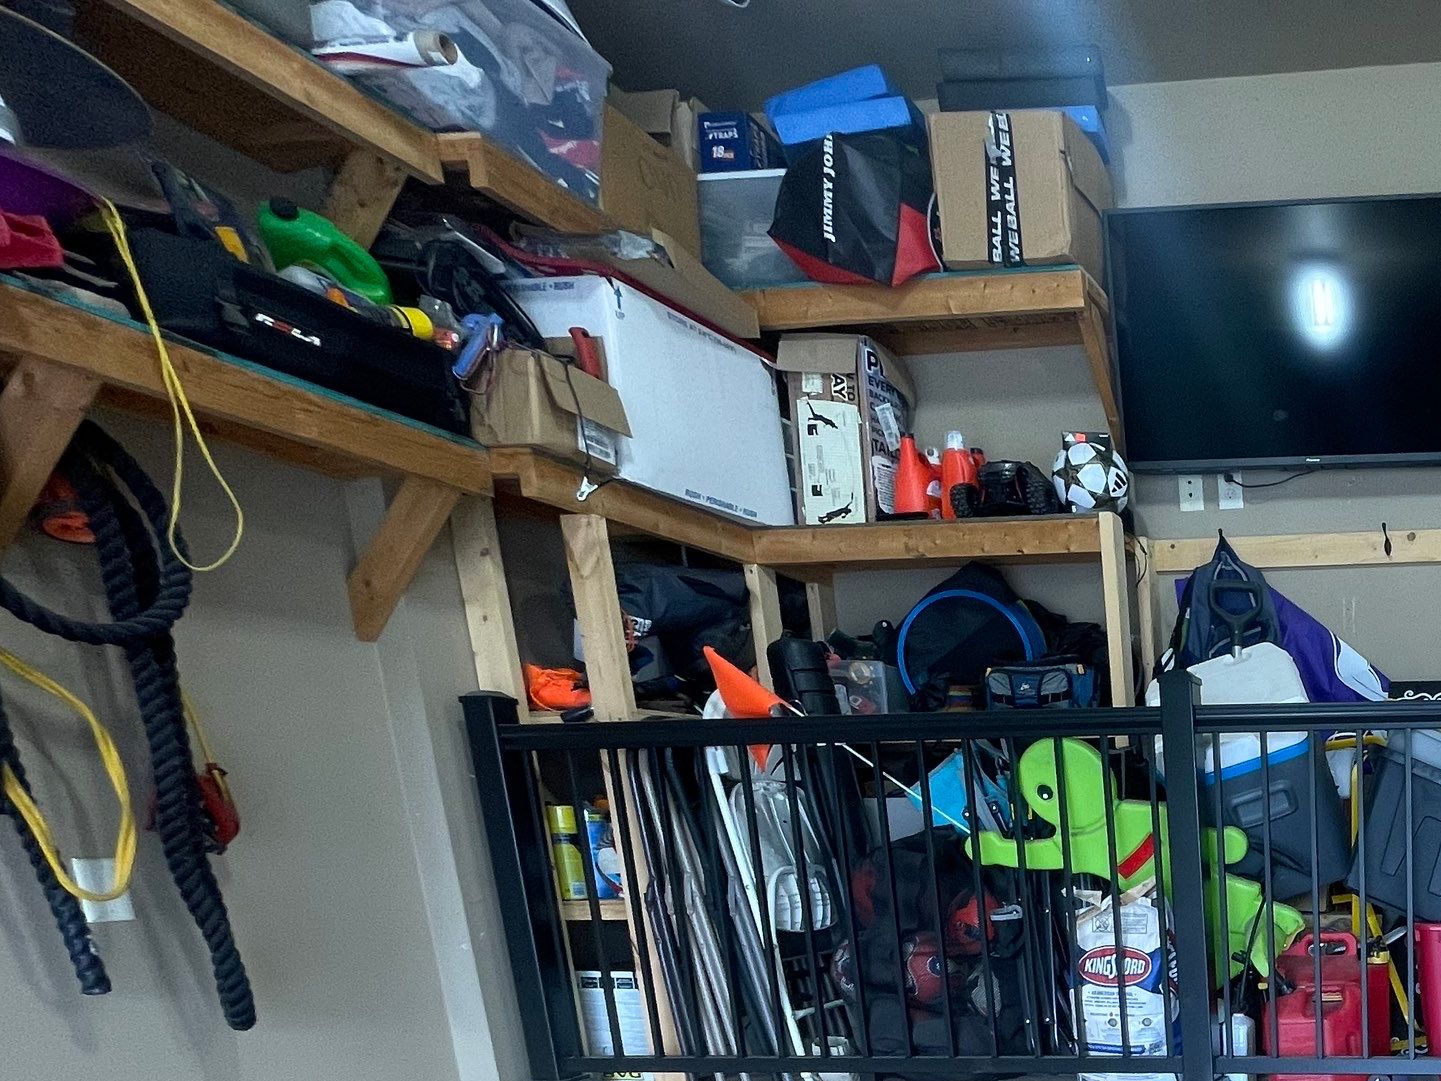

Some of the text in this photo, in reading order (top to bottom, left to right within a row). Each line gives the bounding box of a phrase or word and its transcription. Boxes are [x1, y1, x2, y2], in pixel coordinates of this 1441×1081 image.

[823, 178, 836, 243] JIMMY
[990, 158, 1003, 263] BALL WE
[830, 373, 849, 402] AY
[1084, 954, 1146, 979] KINGSORD
